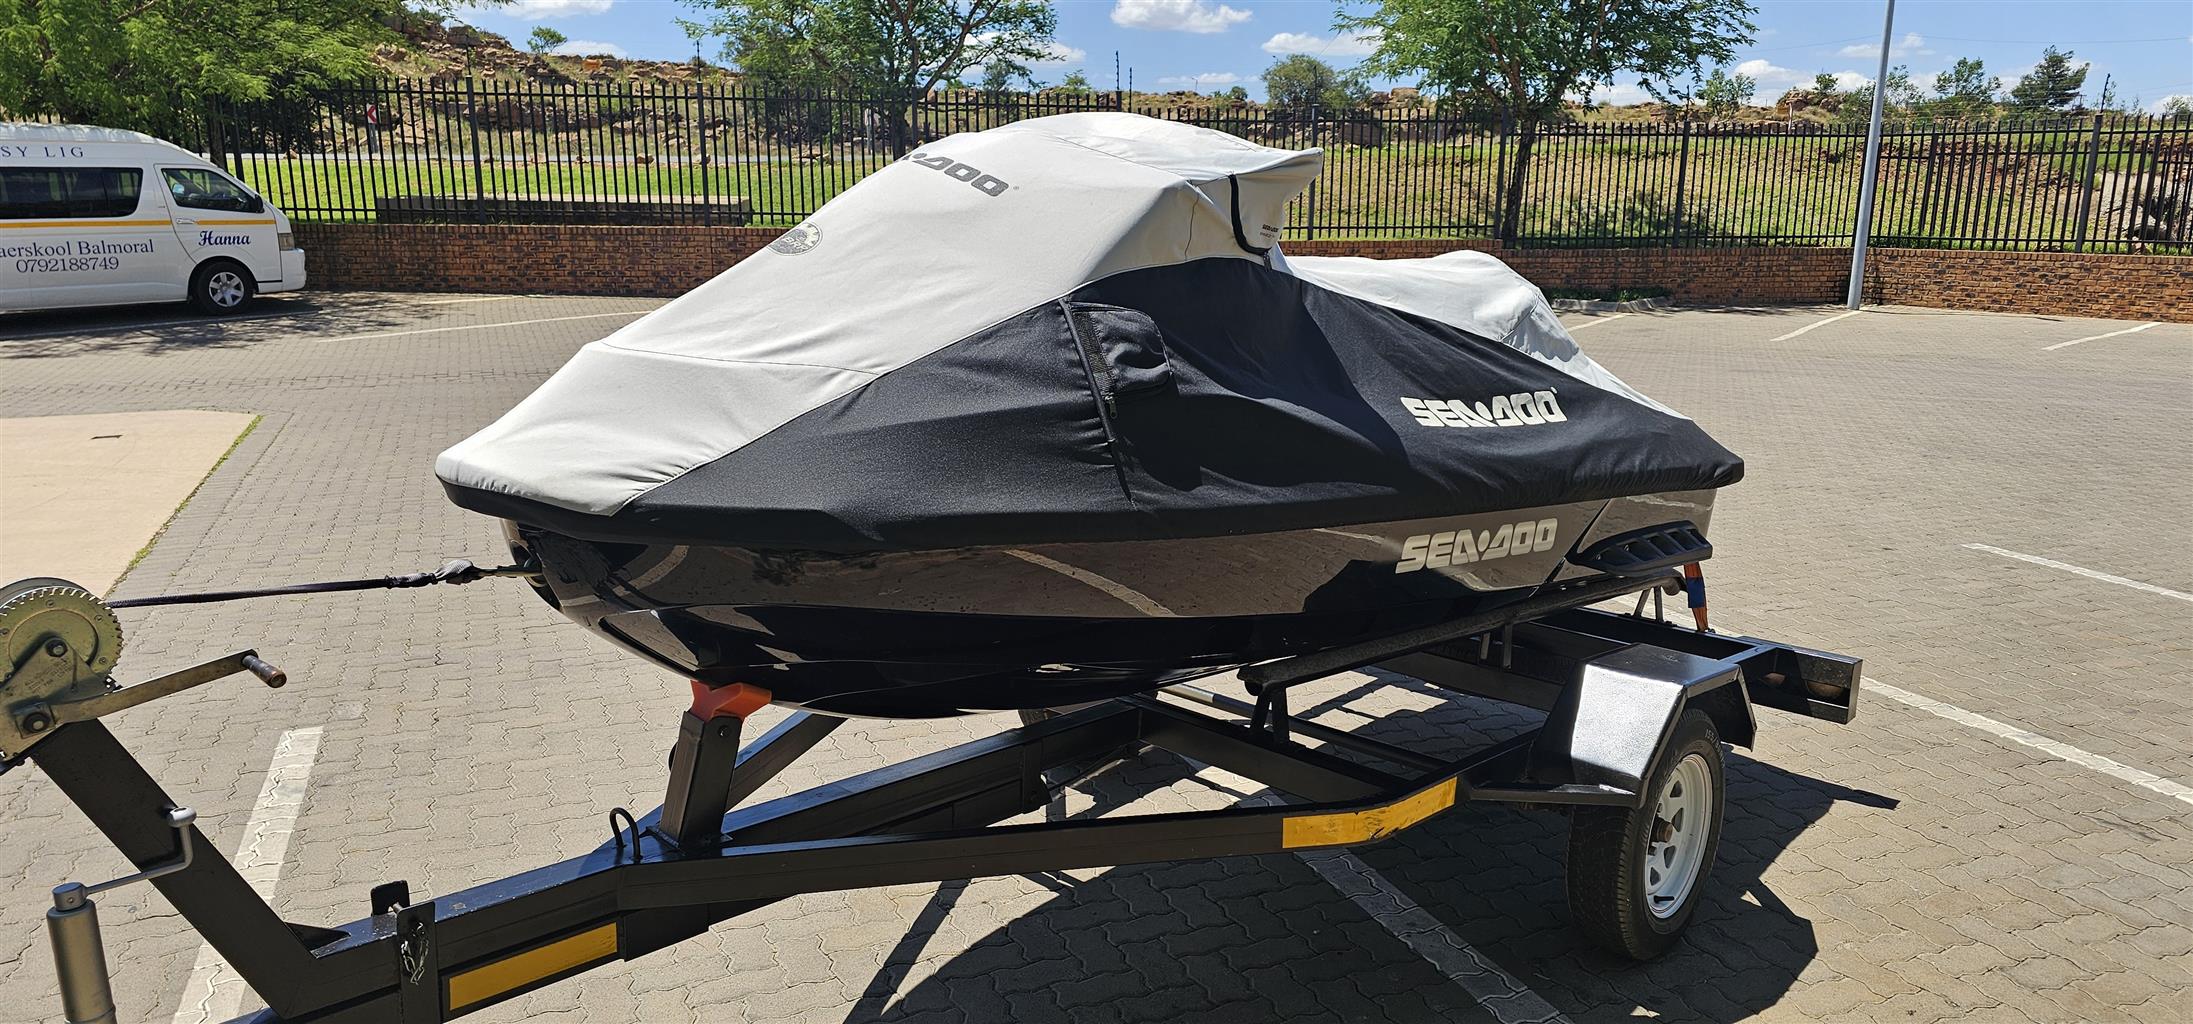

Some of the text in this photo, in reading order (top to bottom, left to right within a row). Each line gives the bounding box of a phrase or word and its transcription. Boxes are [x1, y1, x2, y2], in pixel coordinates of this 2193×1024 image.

[44, 146, 84, 158] LIG
[198, 230, 251, 246] Hanna
[78, 239, 154, 256] Balmoral
[16, 256, 119, 273] 0792188749
